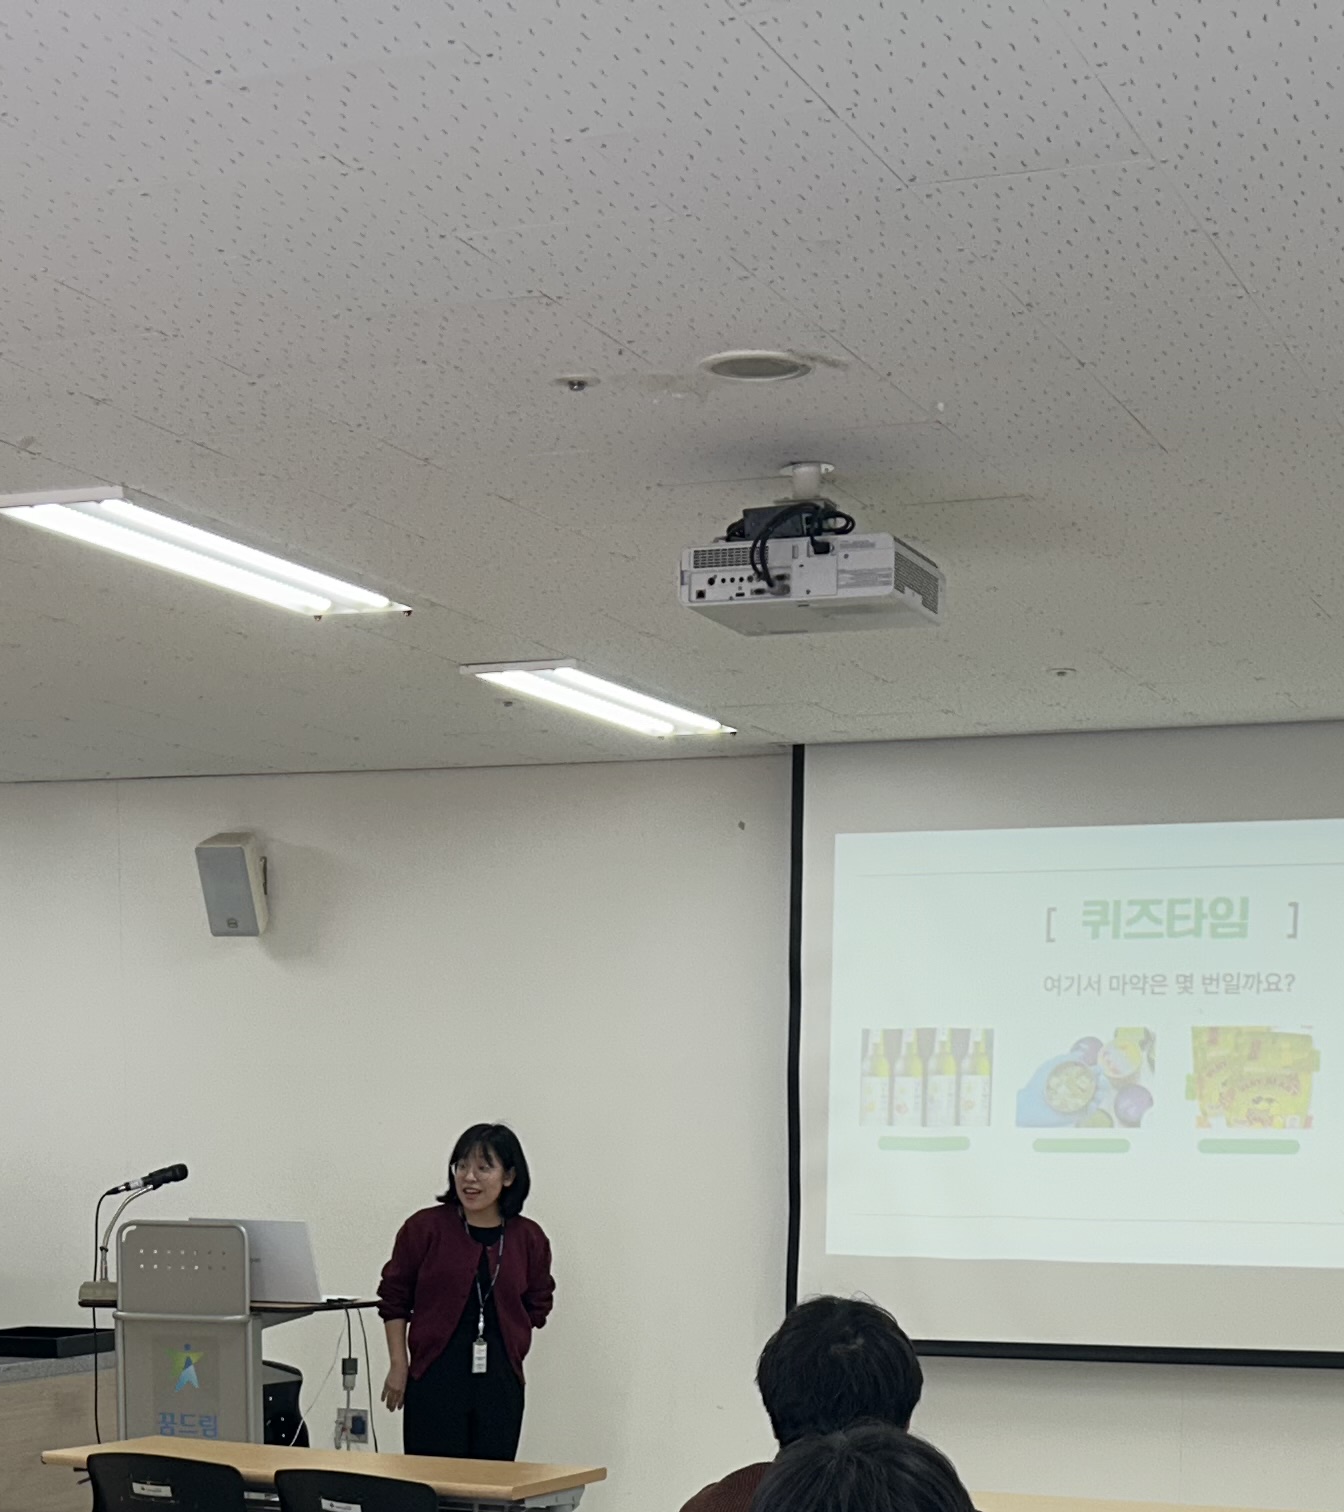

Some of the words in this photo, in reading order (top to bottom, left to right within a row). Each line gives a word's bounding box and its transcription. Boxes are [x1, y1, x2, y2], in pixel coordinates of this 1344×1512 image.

[1081, 895, 1250, 940] 퀴즈타임
[1043, 973, 1103, 997] 여기서
[1108, 972, 1169, 996] 마약은
[1175, 972, 1195, 996] 몇
[1201, 971, 1297, 996] 번일까요?
[158, 1412, 219, 1438] 꿈드림
